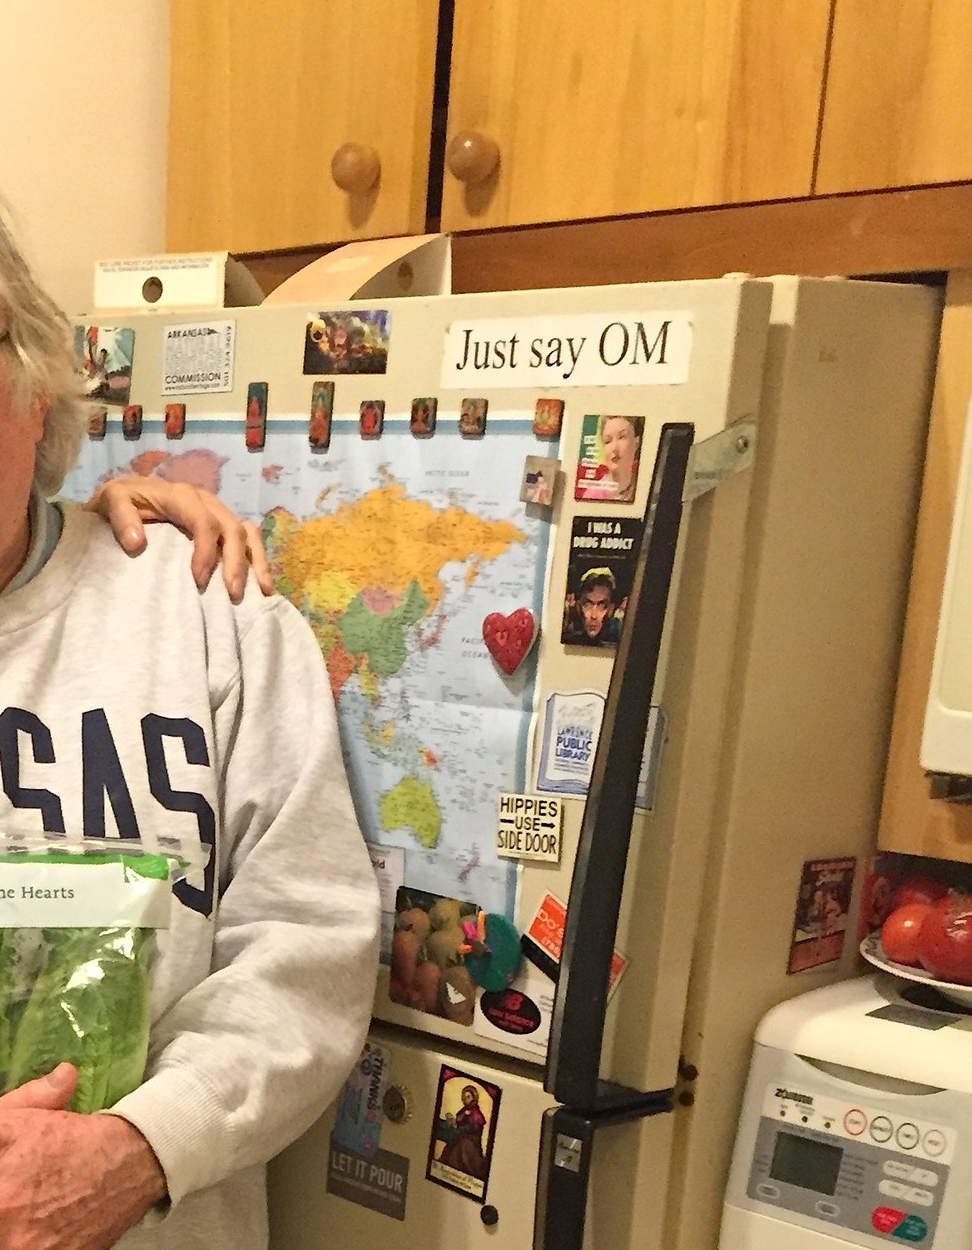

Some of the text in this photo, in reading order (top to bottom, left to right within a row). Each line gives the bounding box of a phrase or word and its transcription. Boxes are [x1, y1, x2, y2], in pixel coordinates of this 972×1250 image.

[456, 320, 673, 380] Just say OM
[164, 372, 221, 385] COMMISSION
[587, 521, 621, 535] I WAS A
[600, 537, 634, 550] ADDICT
[556, 736, 592, 752] PUBLIC
[555, 748, 591, 762] LIBRARY
[500, 796, 558, 817] HIPPIES
[515, 816, 541, 831] USE
[497, 829, 557, 854] SIDE DOOR
[21, 886, 75, 900] Hearts
[332, 1151, 353, 1173] LET
[355, 1159, 366, 1180] IT
[369, 1165, 404, 1193] POUR
